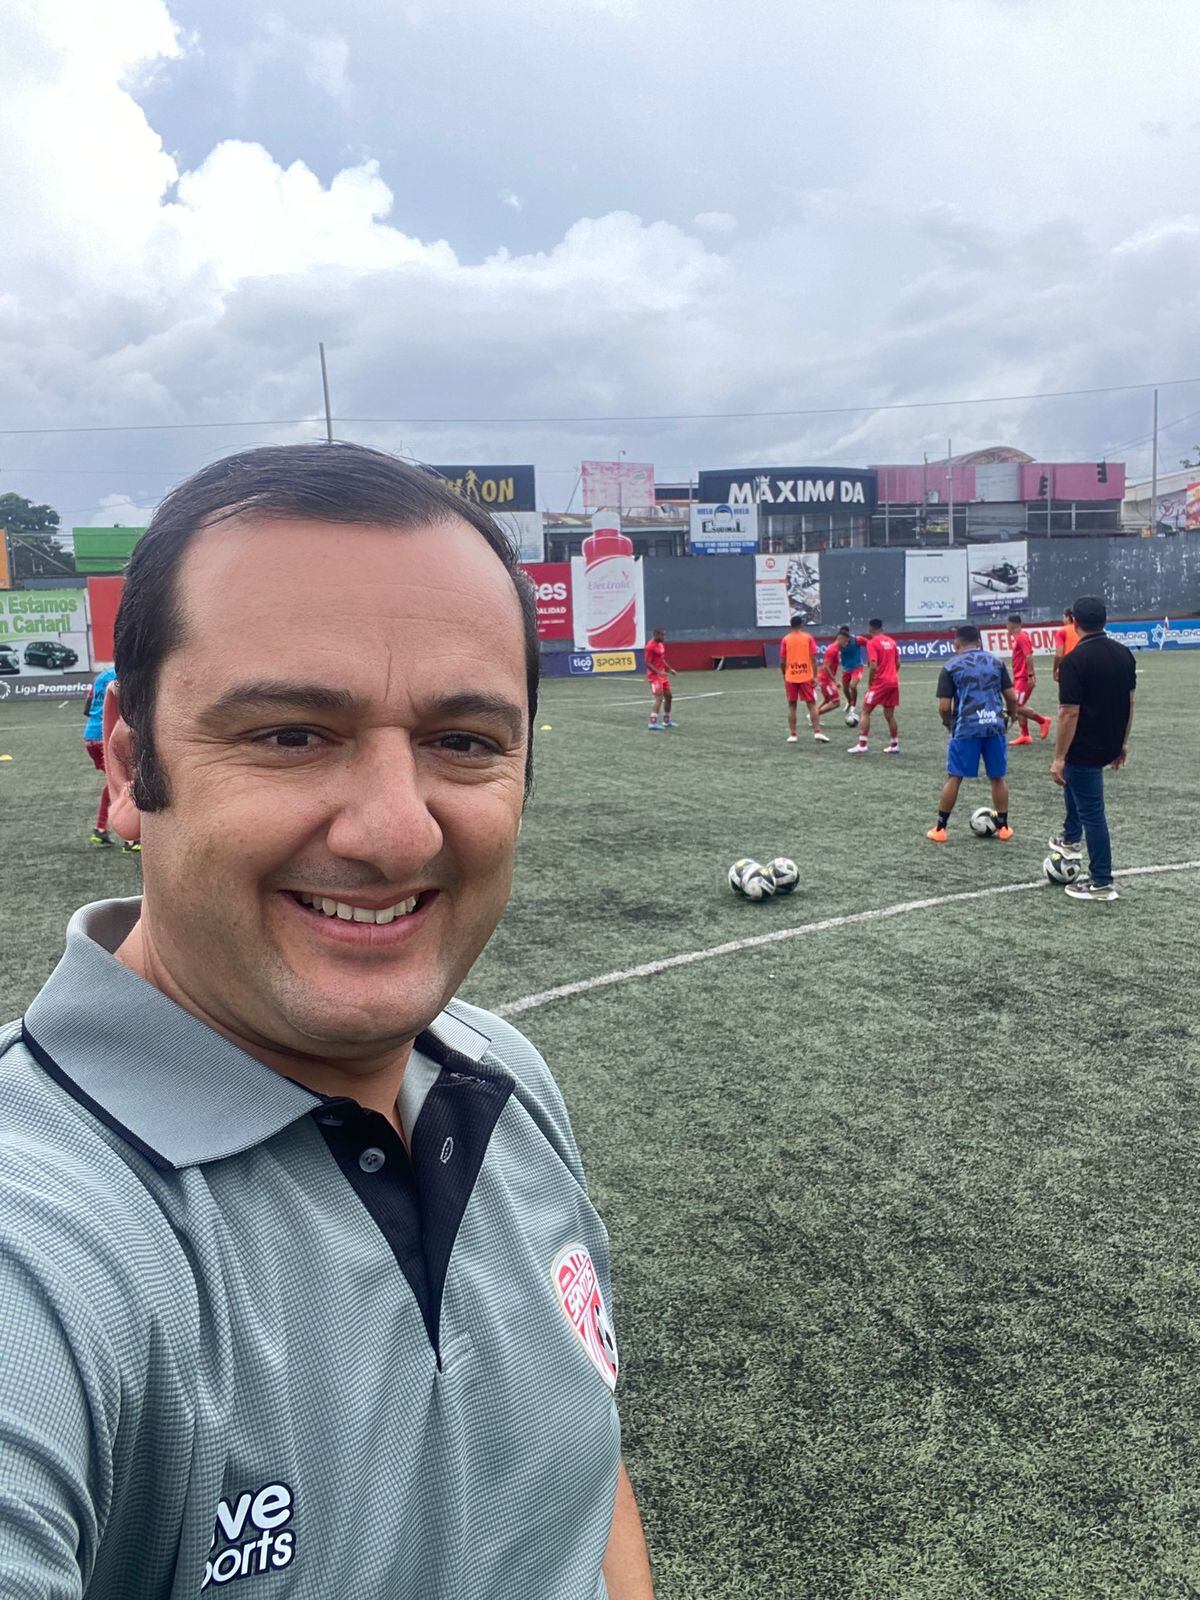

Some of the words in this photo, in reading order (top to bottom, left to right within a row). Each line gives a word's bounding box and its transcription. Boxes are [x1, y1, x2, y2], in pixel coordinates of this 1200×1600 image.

[8, 596, 78, 614] Estamos
[597, 656, 633, 667] SPORTS
[15, 684, 37, 696] Liga
[37, 682, 93, 693] Promerica
[211, 1484, 291, 1546] ve
[201, 1530, 293, 1590] orts
